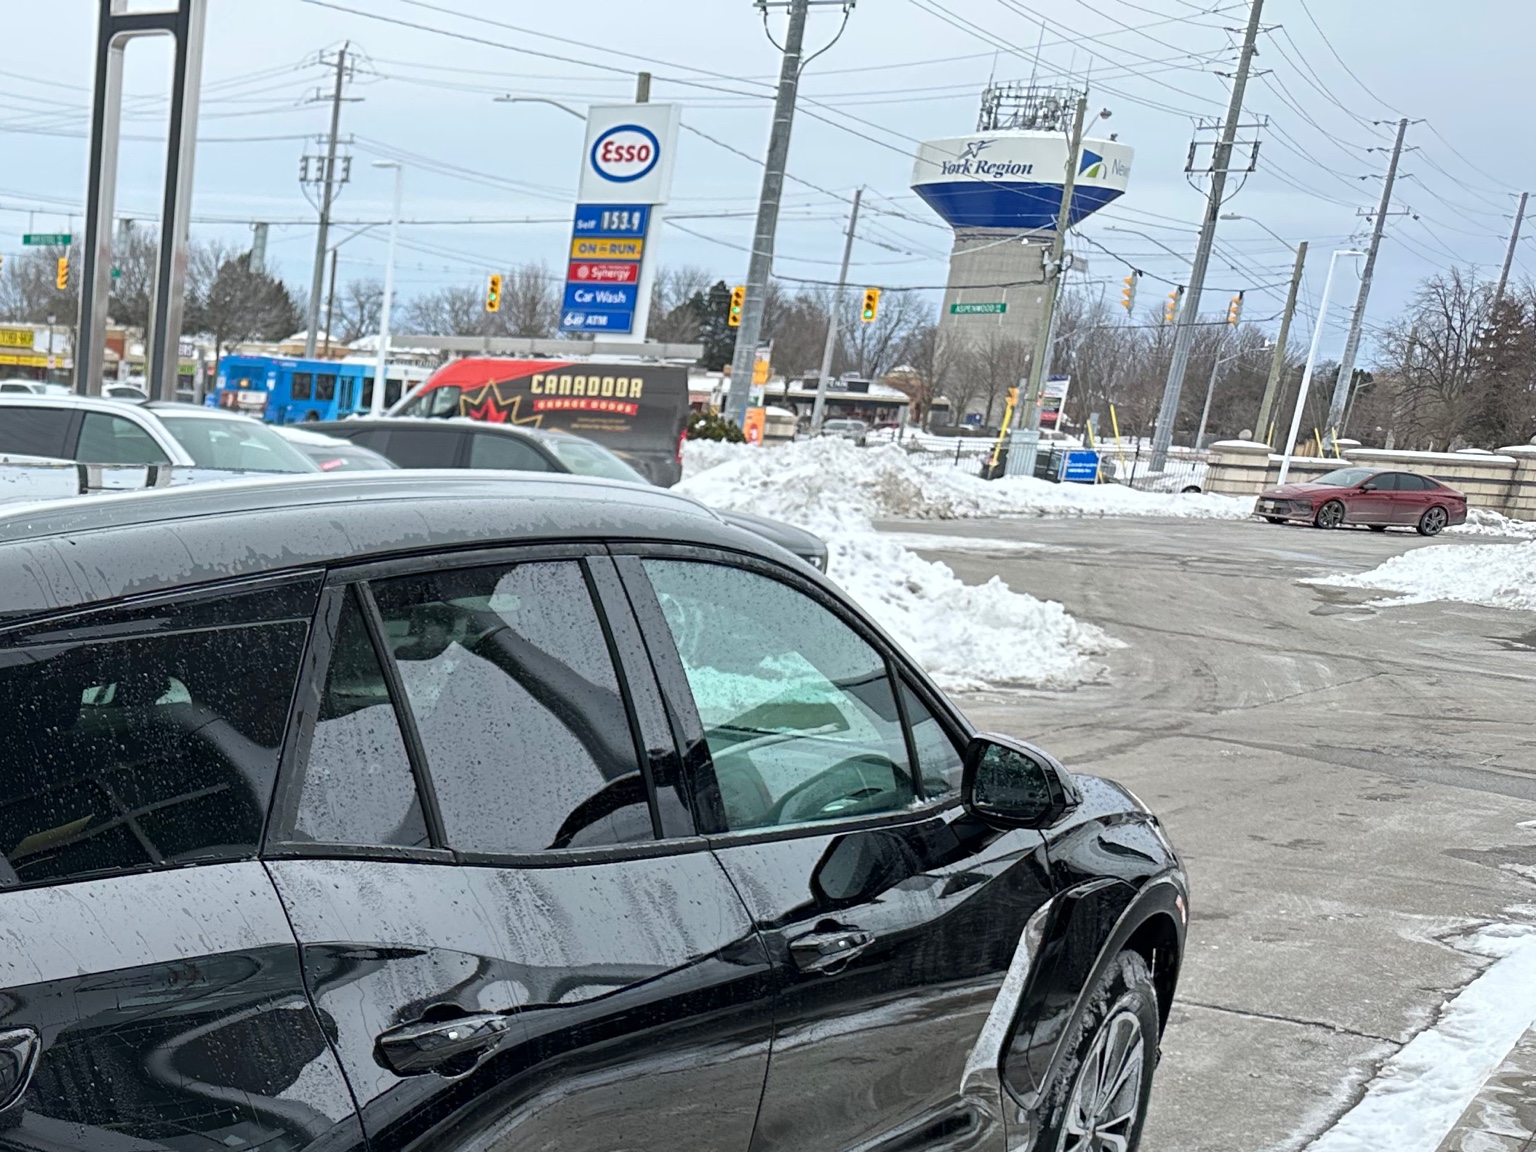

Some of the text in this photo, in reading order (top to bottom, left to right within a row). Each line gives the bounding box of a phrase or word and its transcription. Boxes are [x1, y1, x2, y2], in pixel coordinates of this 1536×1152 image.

[601, 140, 651, 163] Esso
[941, 158, 1033, 178] York Region
[576, 219, 596, 230] Self
[578, 243, 597, 254] ON
[609, 244, 637, 255] RUN
[591, 266, 631, 281] Synergy
[574, 289, 627, 304] Car Wash
[530, 374, 644, 399] CANADOOR
